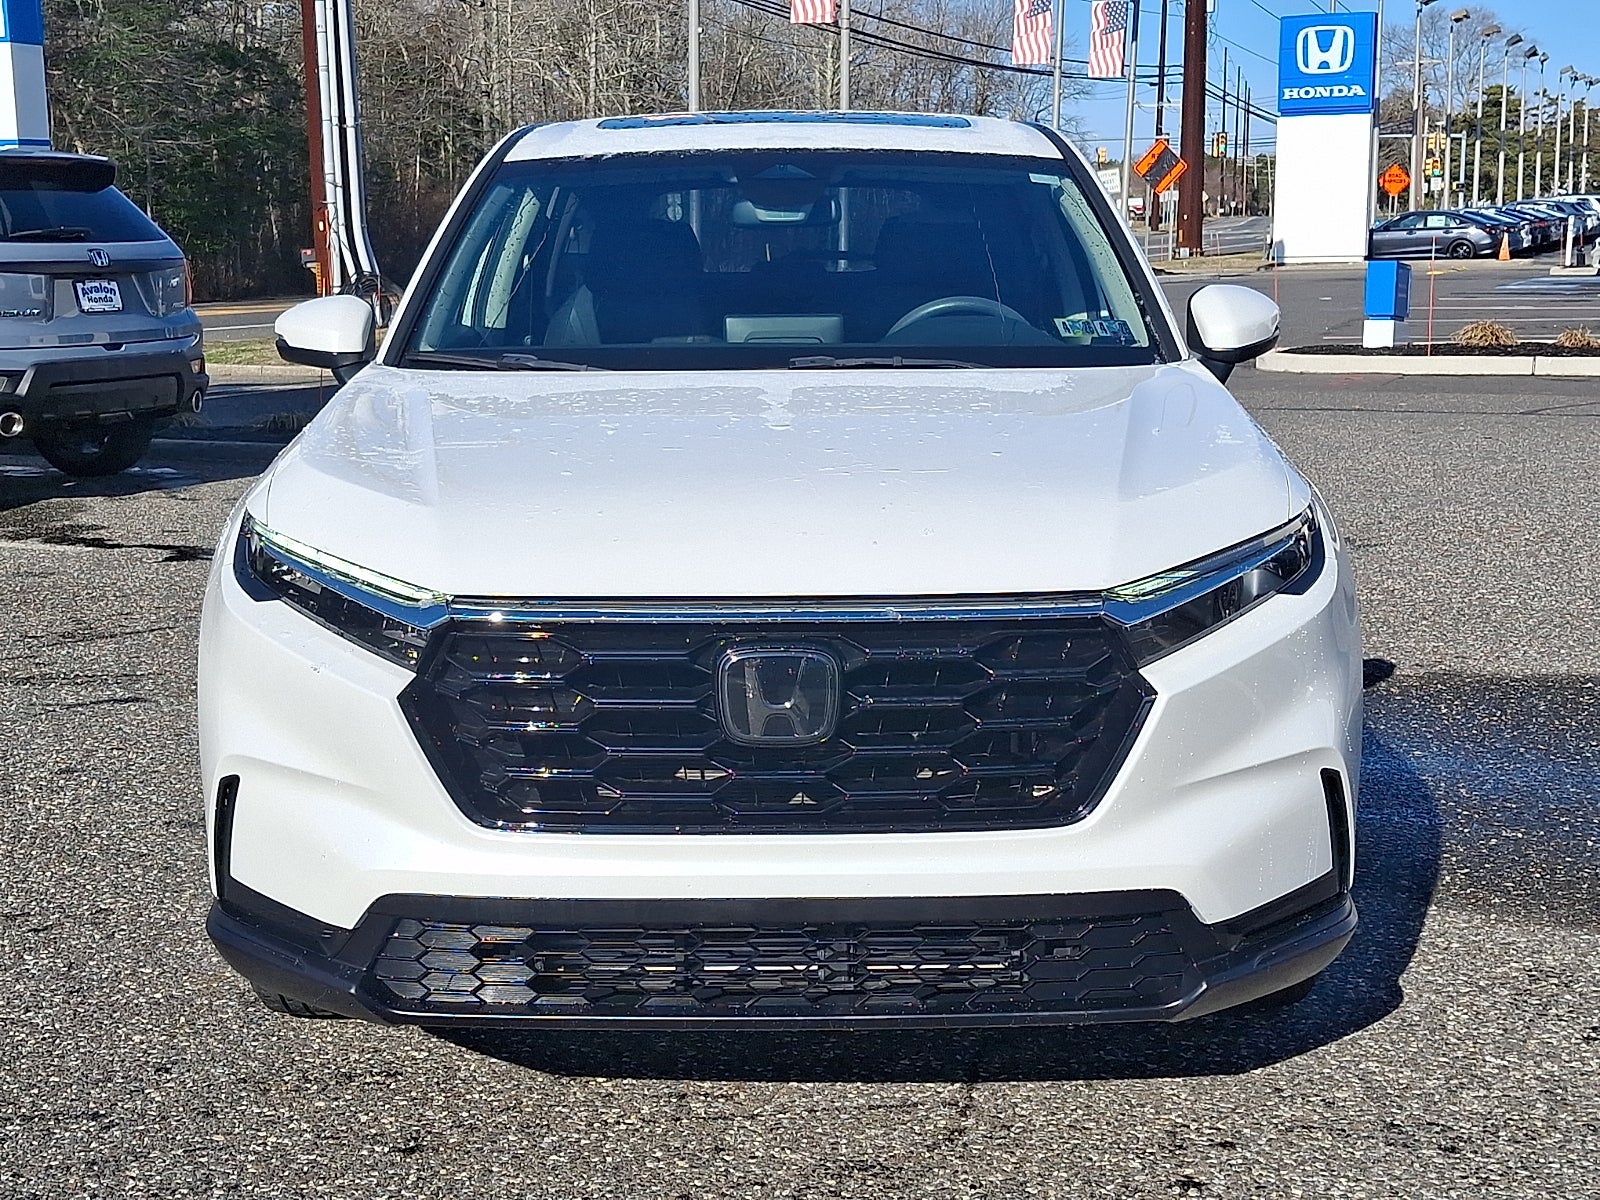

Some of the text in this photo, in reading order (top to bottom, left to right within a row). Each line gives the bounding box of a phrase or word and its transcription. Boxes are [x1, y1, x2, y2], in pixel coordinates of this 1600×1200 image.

[1282, 84, 1366, 100] HONDA
[81, 283, 117, 297] Avalon
[87, 295, 114, 304] Honda
